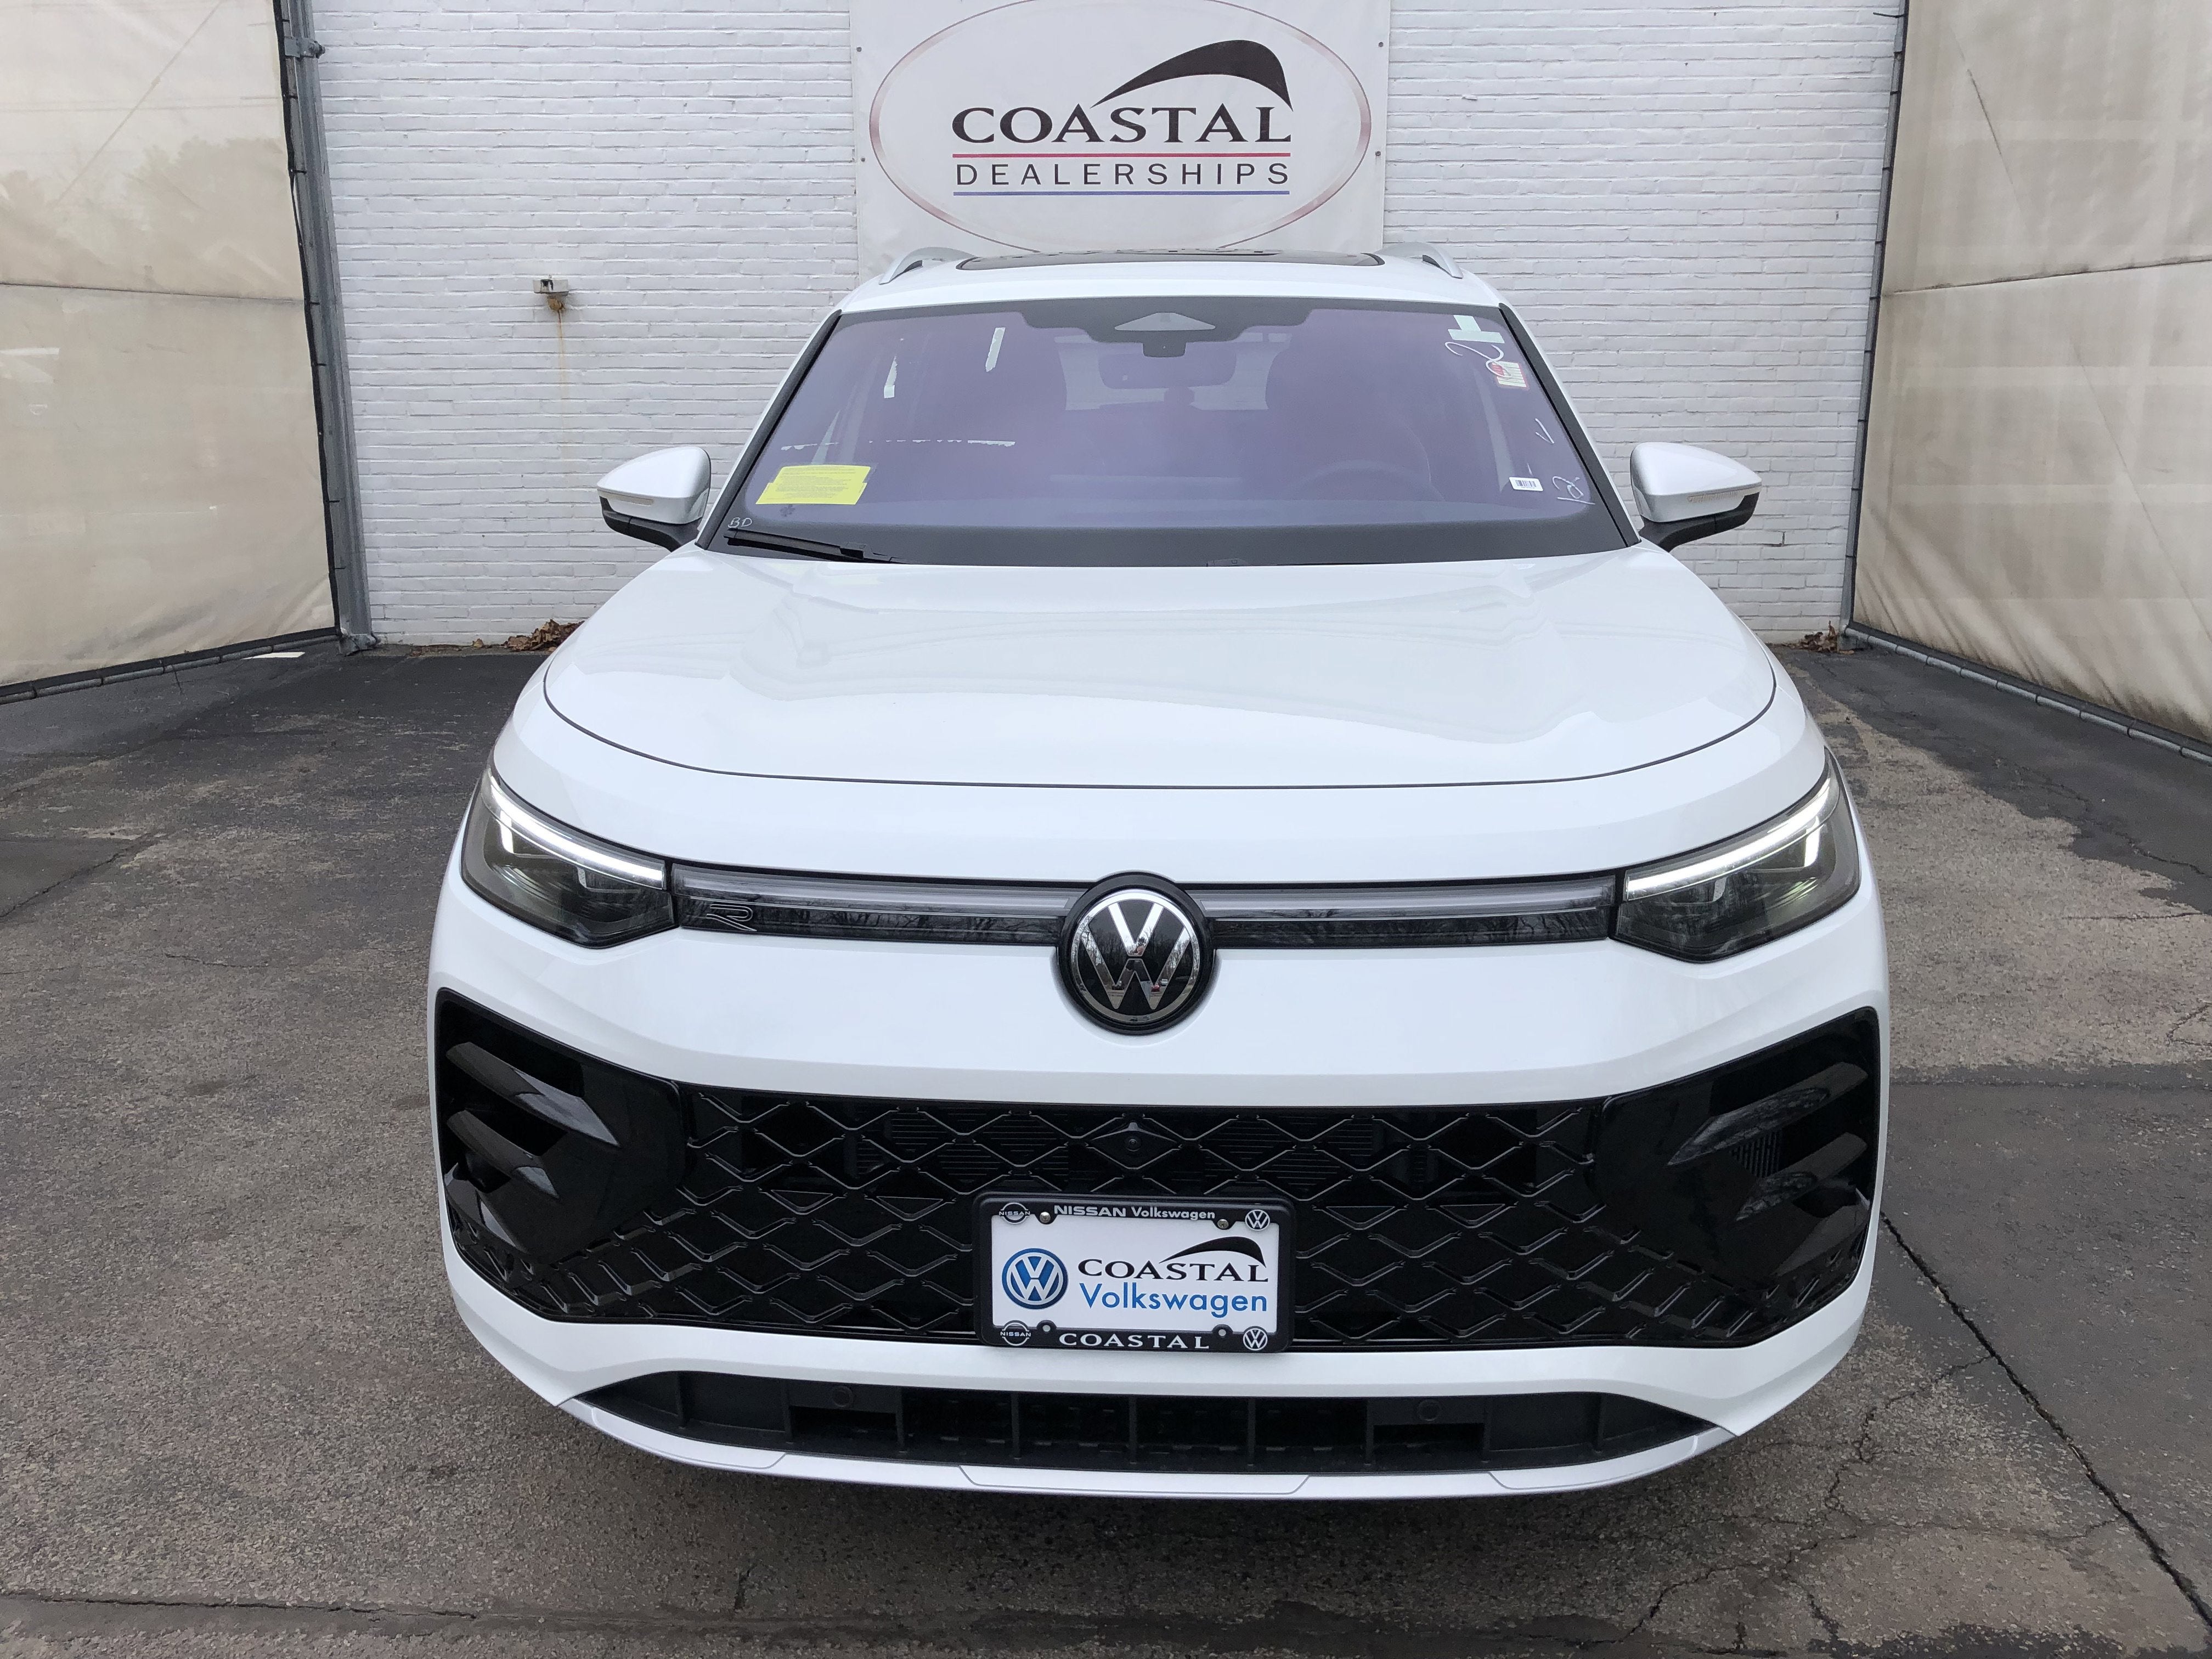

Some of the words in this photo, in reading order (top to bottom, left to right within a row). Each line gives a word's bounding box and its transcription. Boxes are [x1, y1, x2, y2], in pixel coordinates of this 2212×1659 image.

[952, 104, 1291, 144] COASTAL
[957, 162, 1289, 186] DEALERSHIPS
[1054, 1205, 1126, 1217] NISSAN
[1131, 1206, 1215, 1221] Volkswagen
[1078, 1259, 1268, 1283] COASTAL
[1079, 1282, 1267, 1318] Volkswagen
[1059, 1333, 1210, 1349] COASTAL
